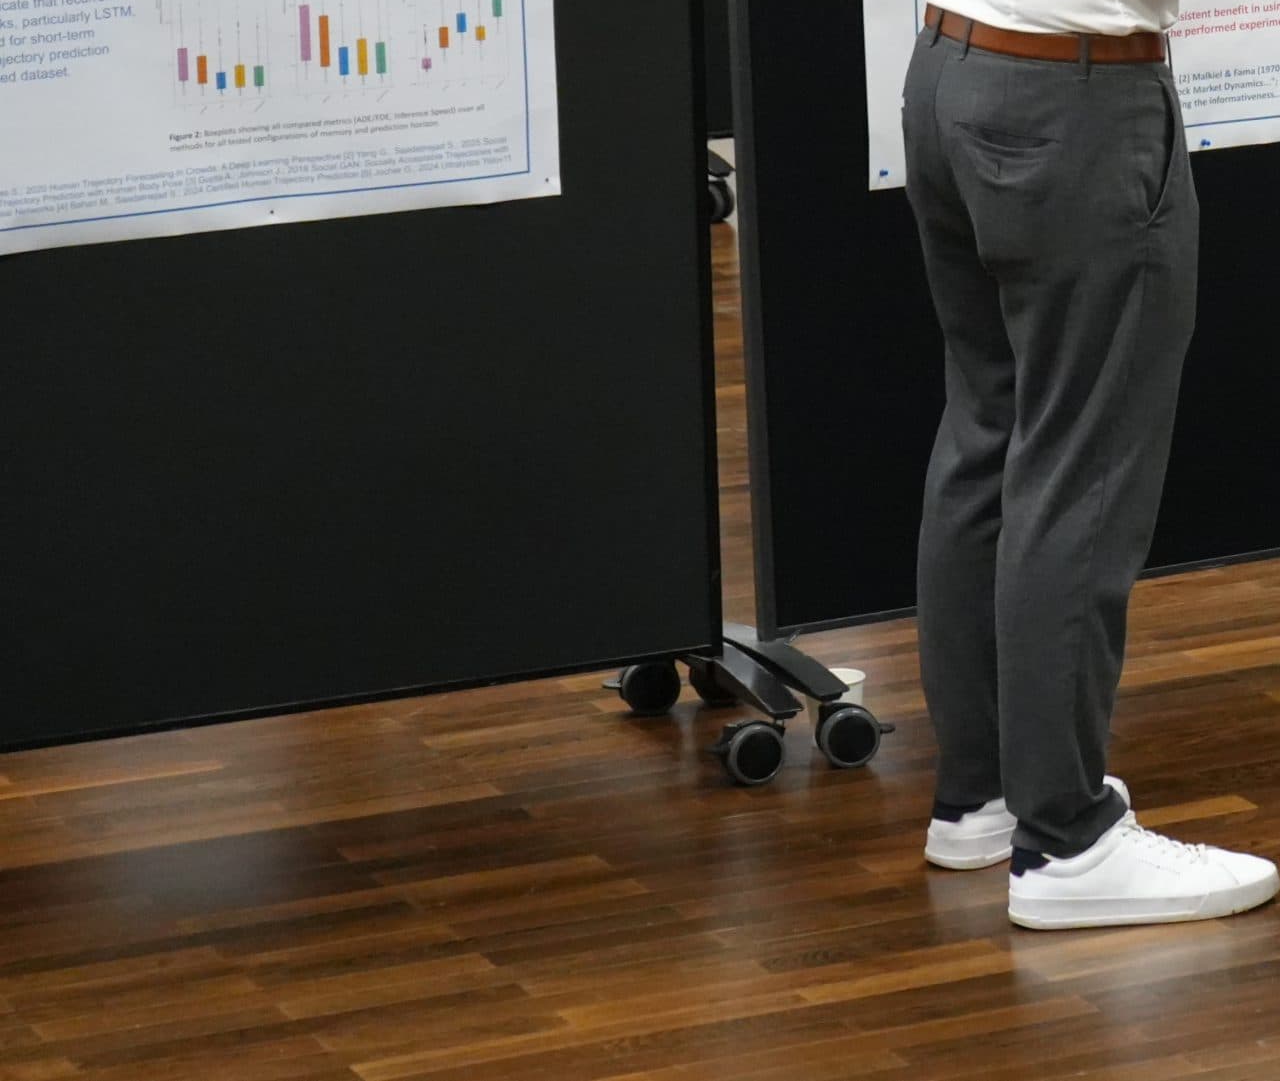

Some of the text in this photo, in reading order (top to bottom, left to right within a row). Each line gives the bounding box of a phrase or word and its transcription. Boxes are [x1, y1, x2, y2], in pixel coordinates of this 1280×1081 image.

[1213, 4, 1248, 16] benefit
[1251, 3, 1260, 13] in
[1184, 21, 1236, 37] performed
